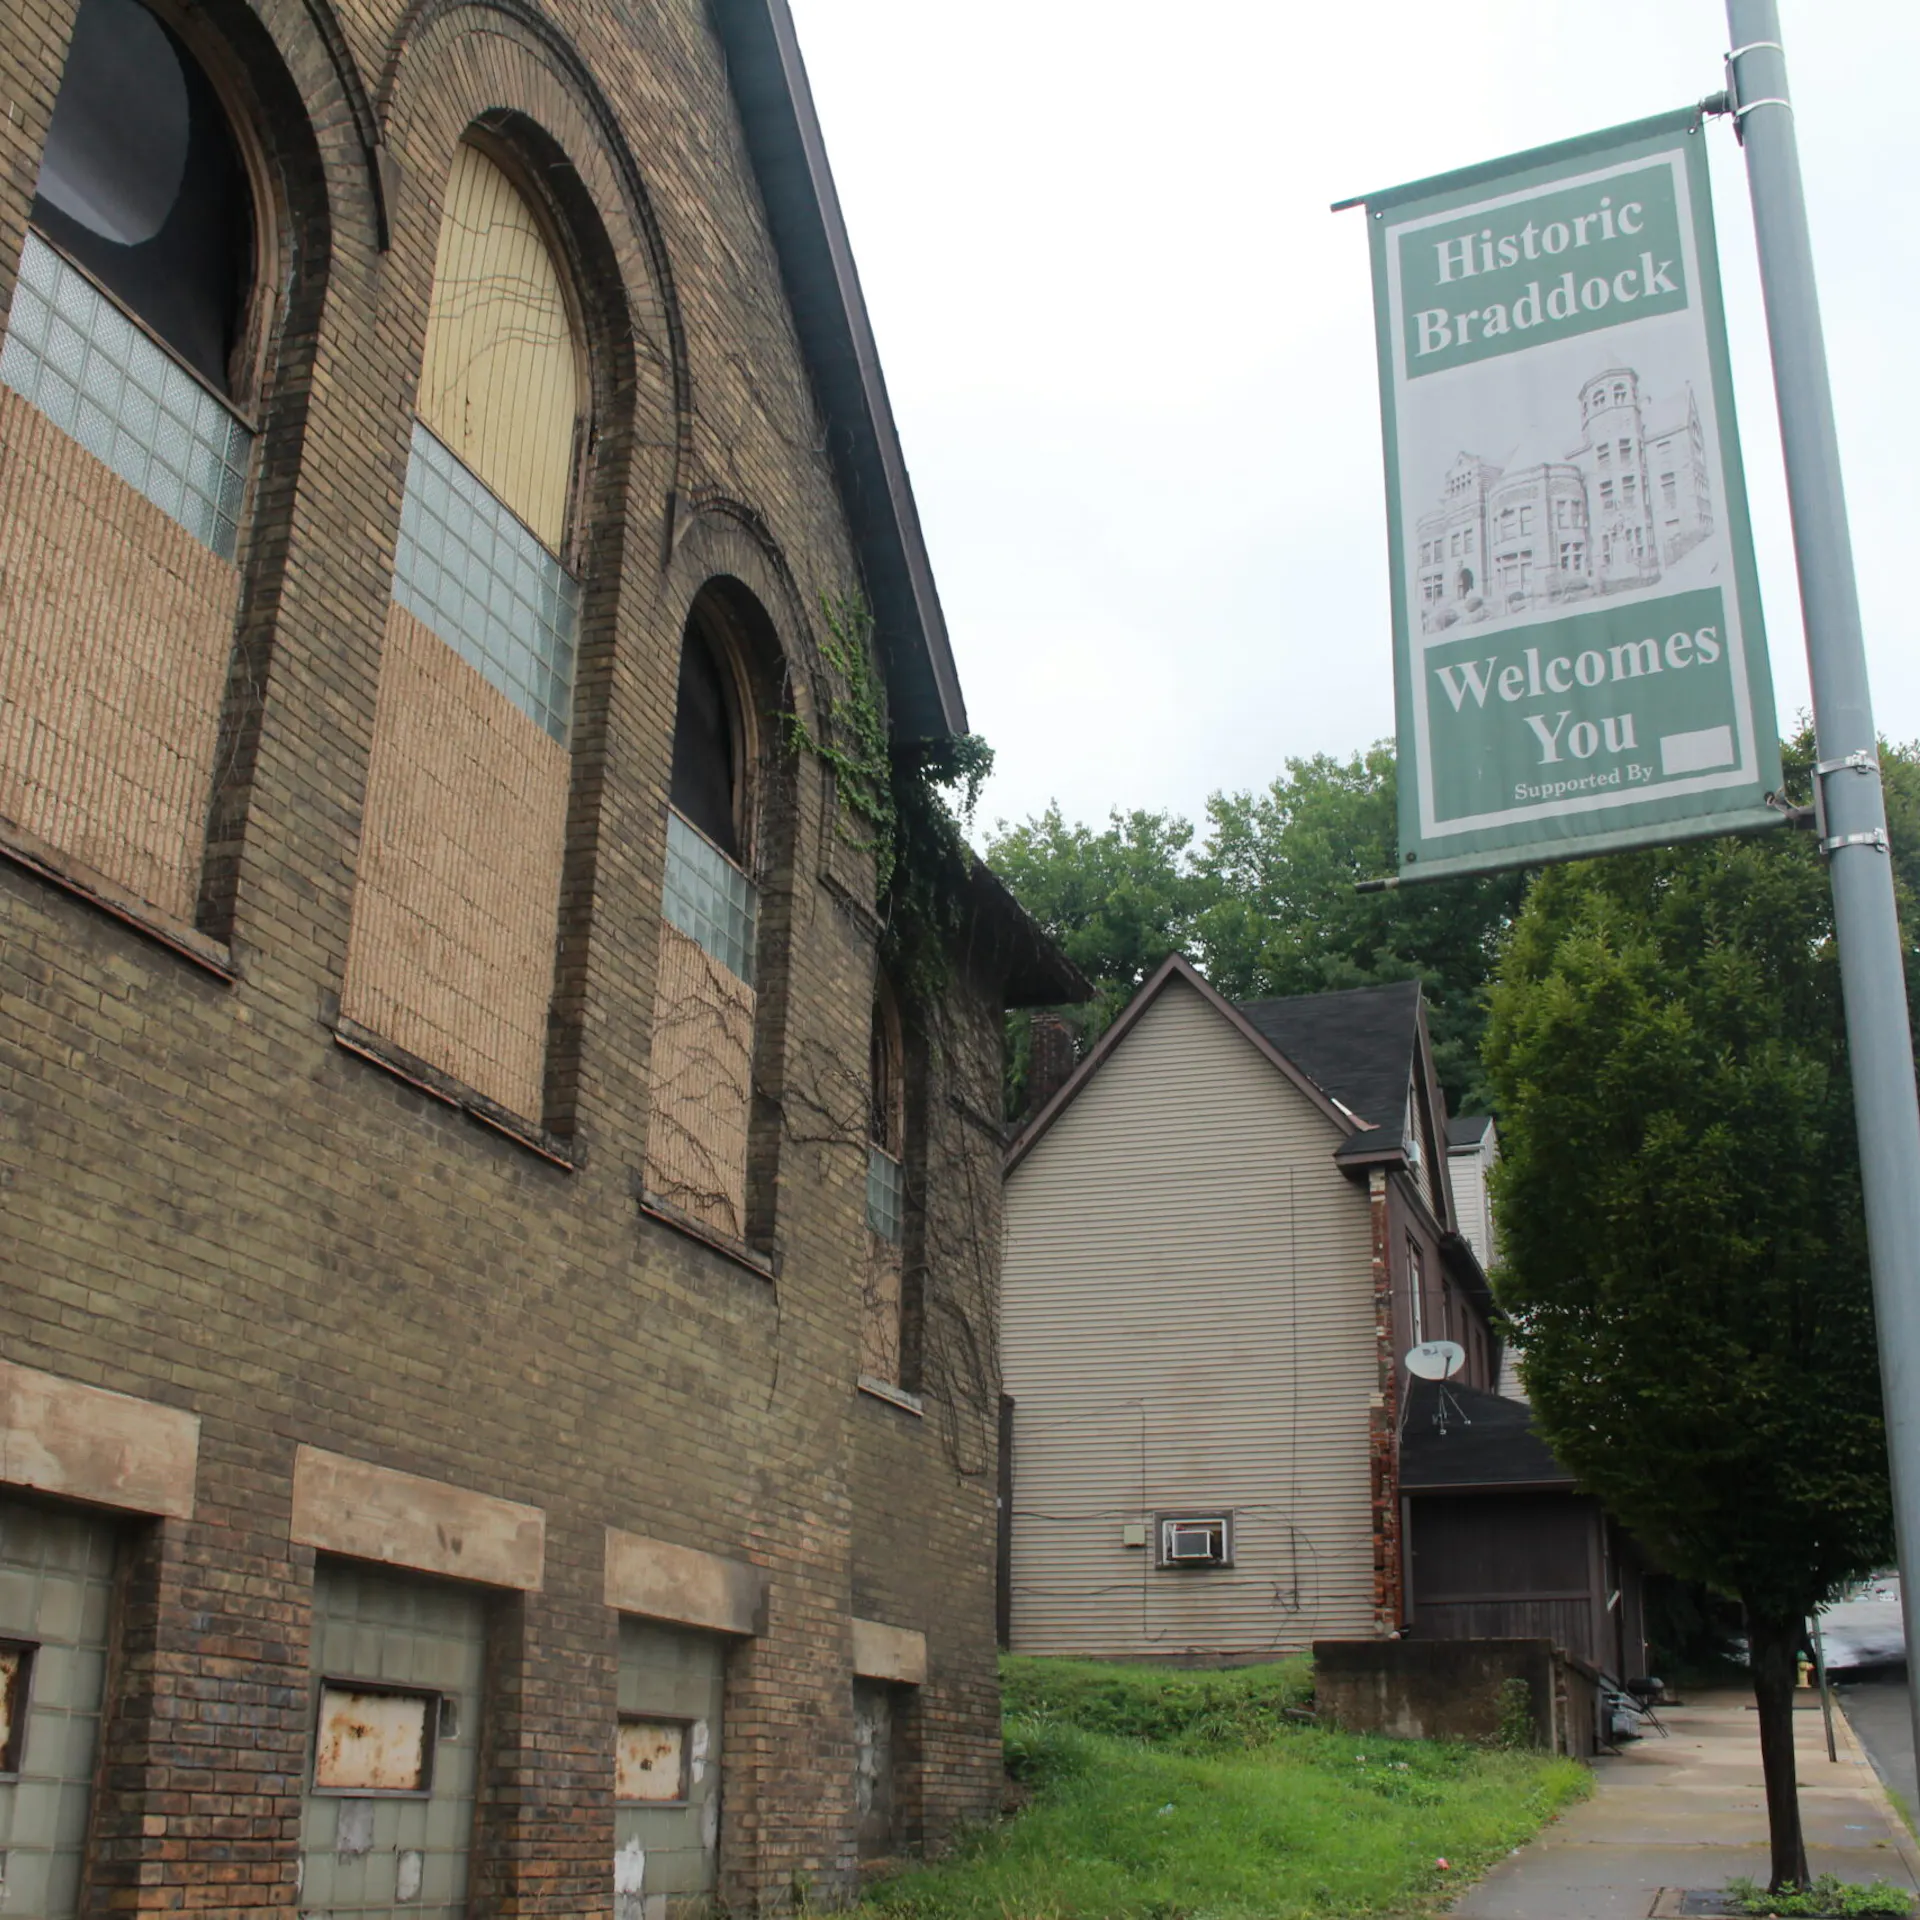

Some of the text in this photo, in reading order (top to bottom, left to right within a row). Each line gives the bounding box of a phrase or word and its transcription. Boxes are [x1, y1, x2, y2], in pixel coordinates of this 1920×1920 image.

[1433, 197, 1644, 286] Historic
[1412, 252, 1679, 358] Braddock
[1433, 626, 1720, 713] Welcomes
[1523, 711, 1638, 765] You
[1514, 764, 1653, 800] Supported By
